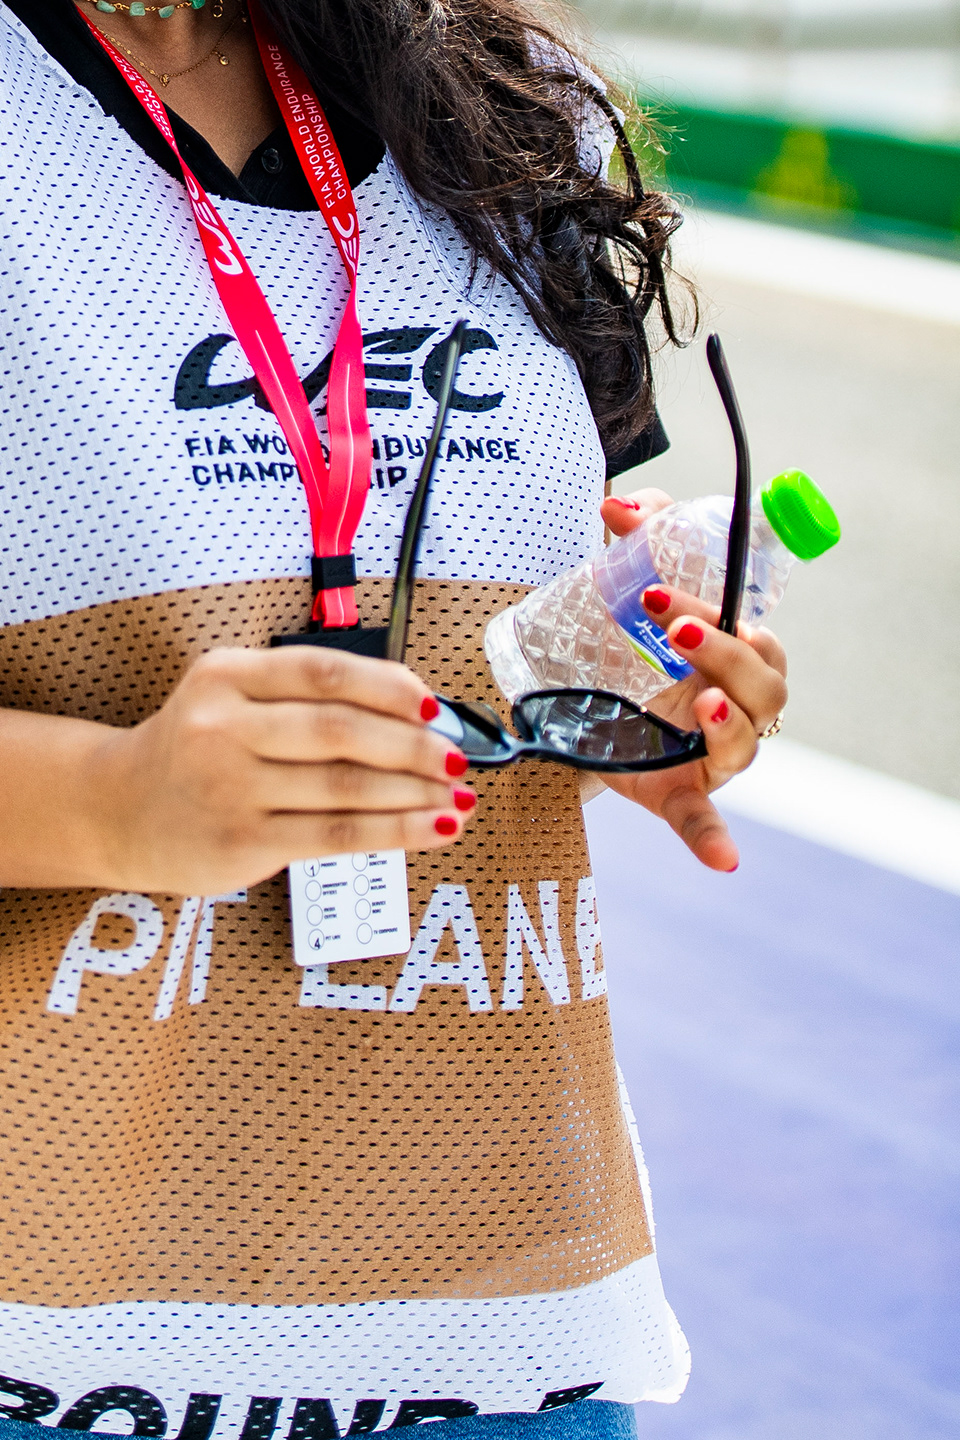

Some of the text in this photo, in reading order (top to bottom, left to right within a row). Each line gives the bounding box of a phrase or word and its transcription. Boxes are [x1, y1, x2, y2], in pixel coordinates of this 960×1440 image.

[268, 45, 336, 209] FIA WORLD ENDURANCE
[302, 93, 347, 200] CHAMPIONSHIP
[184, 175, 244, 275] WEC
[173, 327, 504, 412] WEC
[185, 435, 237, 458] FIA
[372, 437, 521, 460] DUANCE
[192, 461, 407, 490] CHAMPIP
[642, 635, 672, 664] AQUA CLEAR
[309, 865, 315, 876] 1
[45, 876, 608, 1021] PIT LANE
[314, 937, 321, 950] 4
